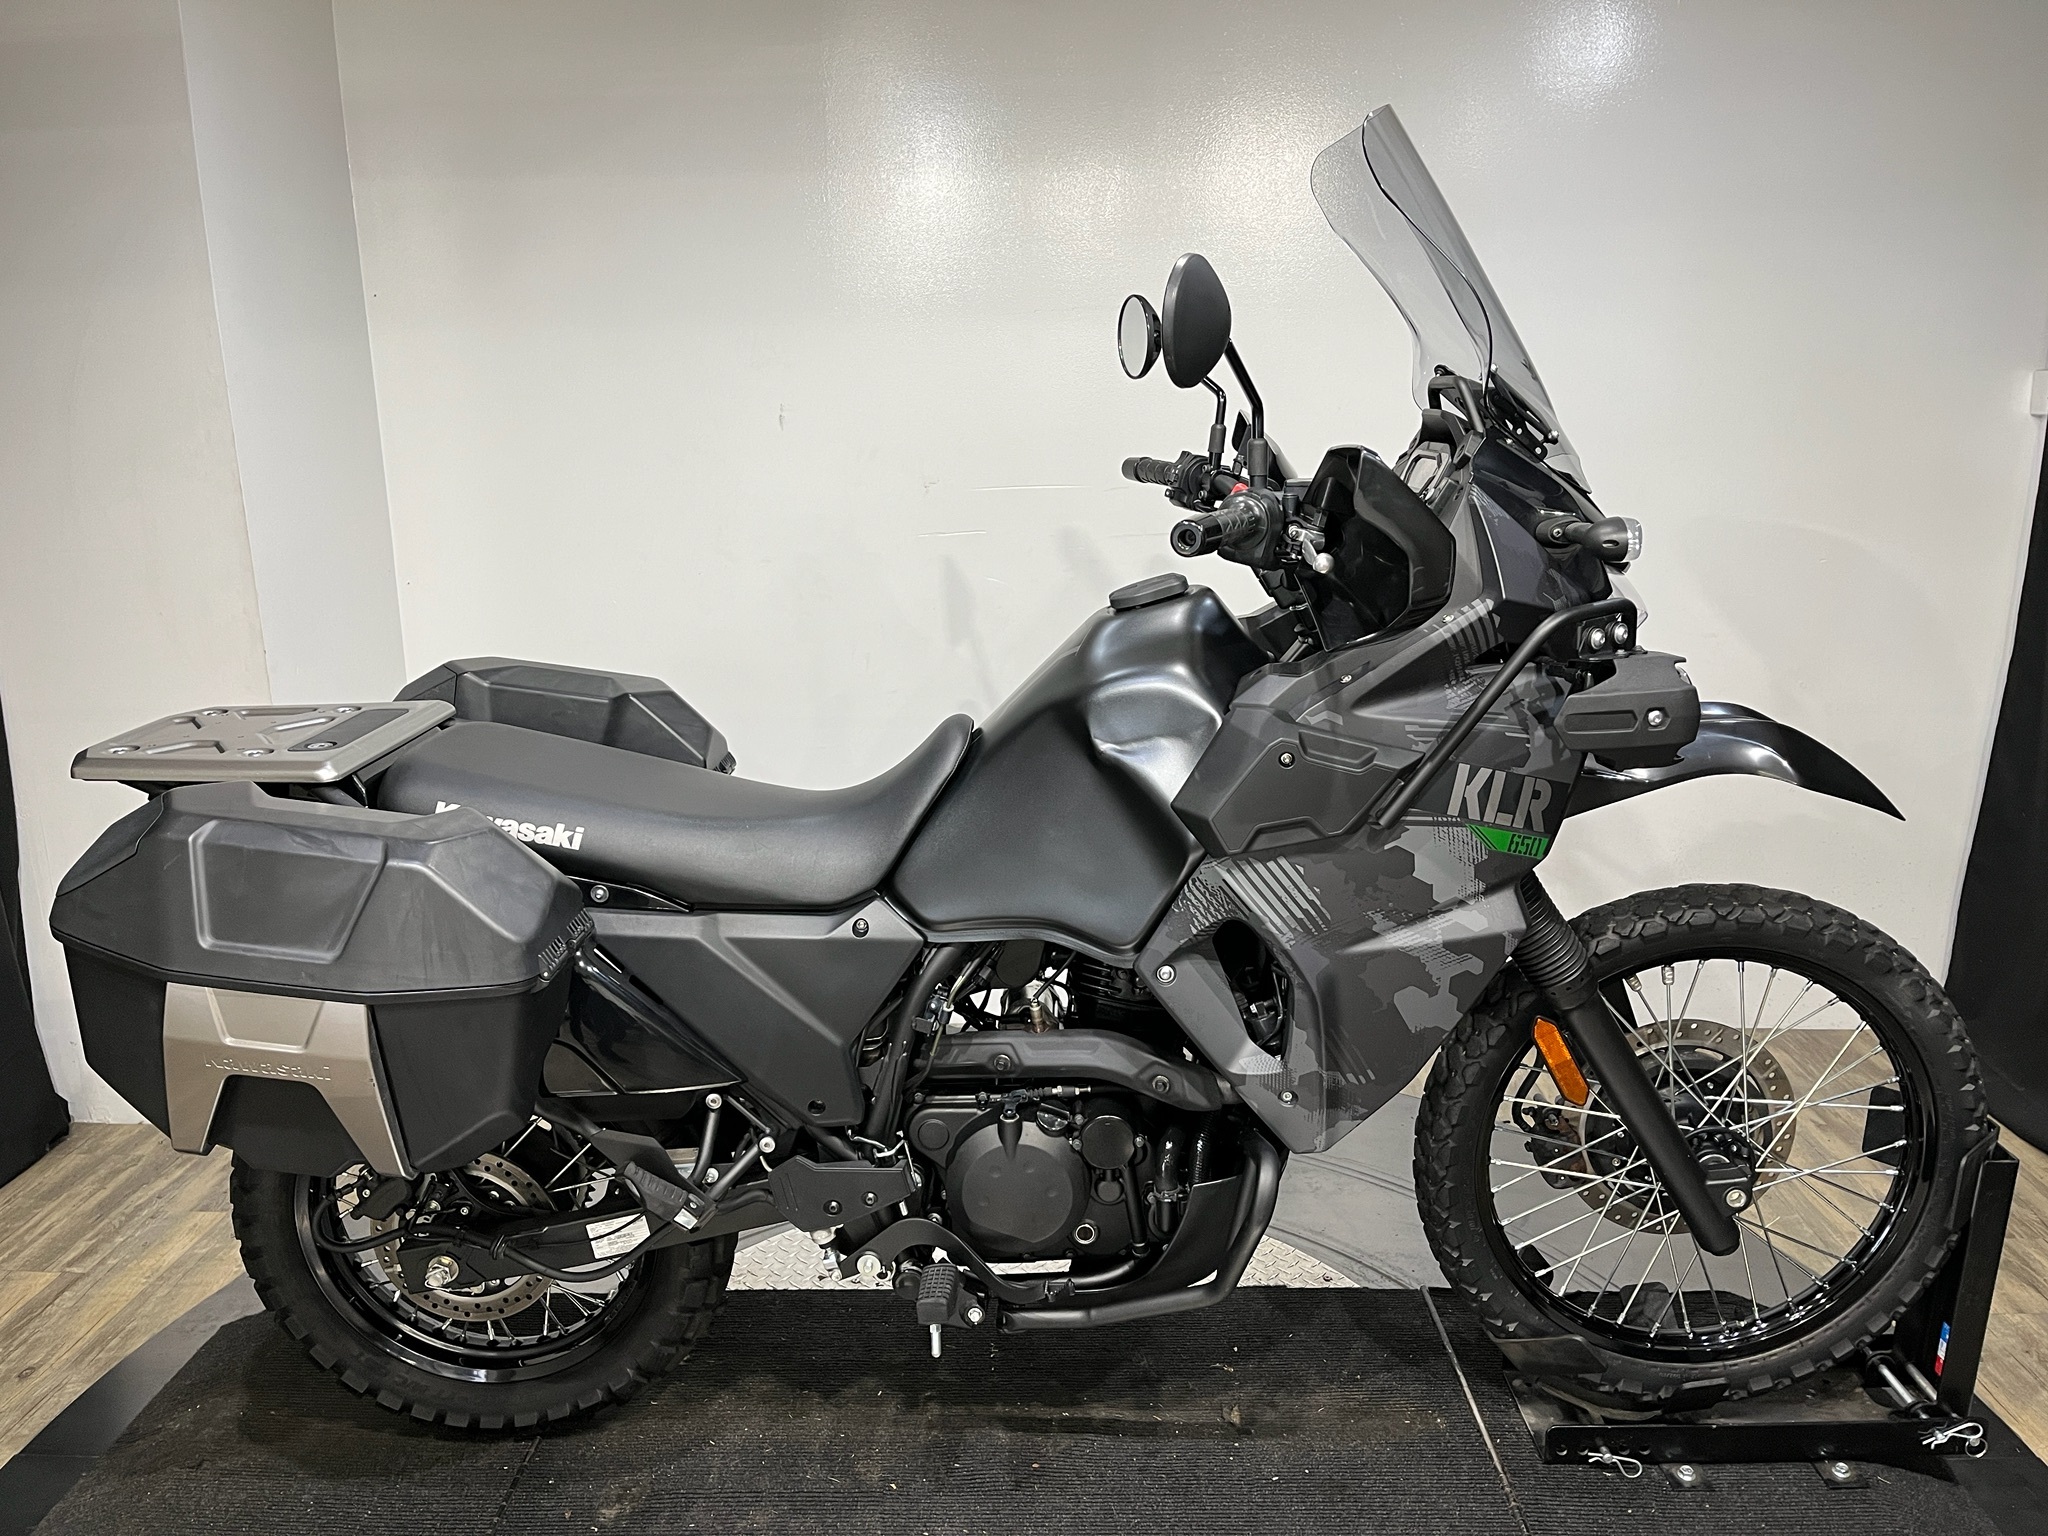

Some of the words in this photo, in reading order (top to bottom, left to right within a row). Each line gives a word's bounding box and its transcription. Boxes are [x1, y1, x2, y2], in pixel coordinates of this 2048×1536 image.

[1447, 763, 1553, 833] KLR
[434, 800, 585, 850] Kasaki
[1508, 833, 1542, 857] 650
